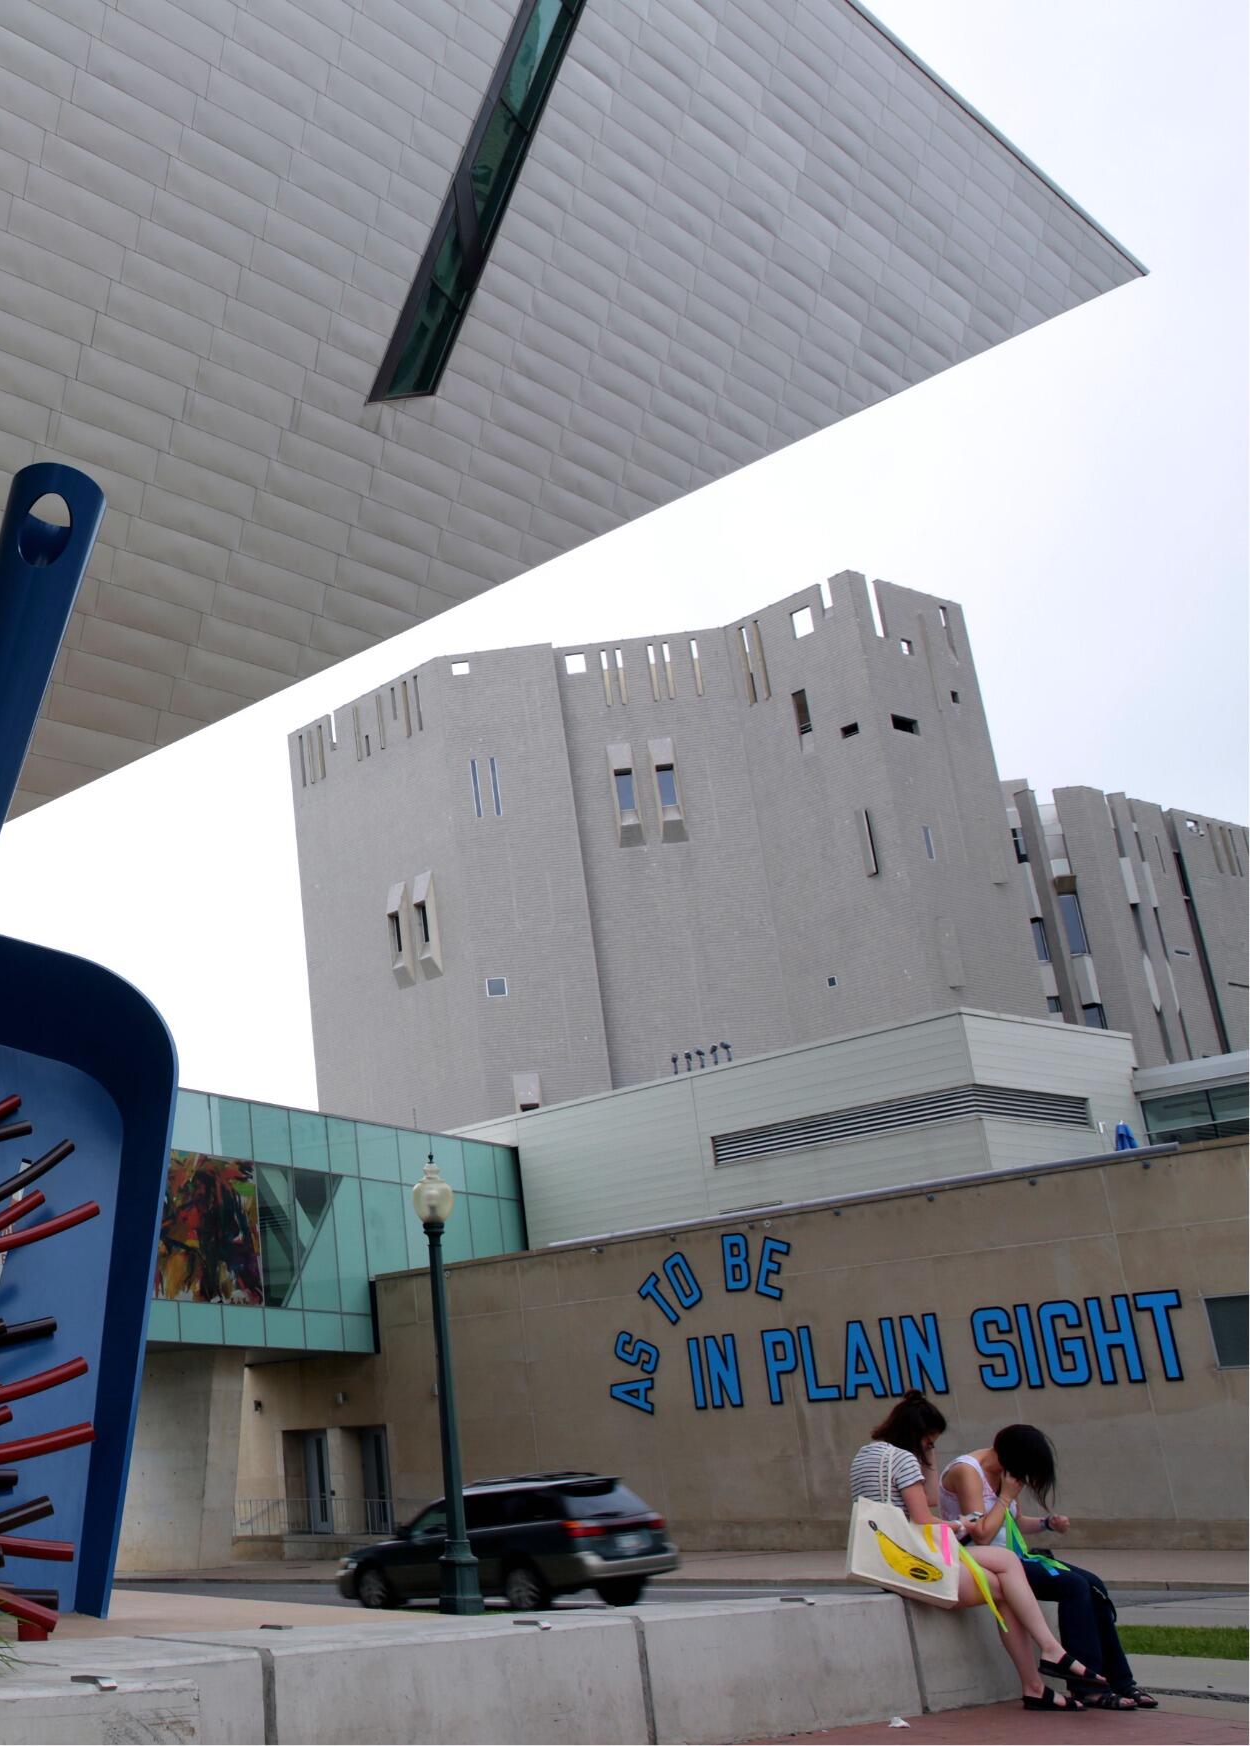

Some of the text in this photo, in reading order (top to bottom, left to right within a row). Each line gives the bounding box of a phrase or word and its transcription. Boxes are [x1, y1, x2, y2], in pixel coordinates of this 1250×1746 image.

[610, 1233, 791, 1414] AS TO BE
[687, 1289, 1185, 1410] IN PLAIN SIGHT
